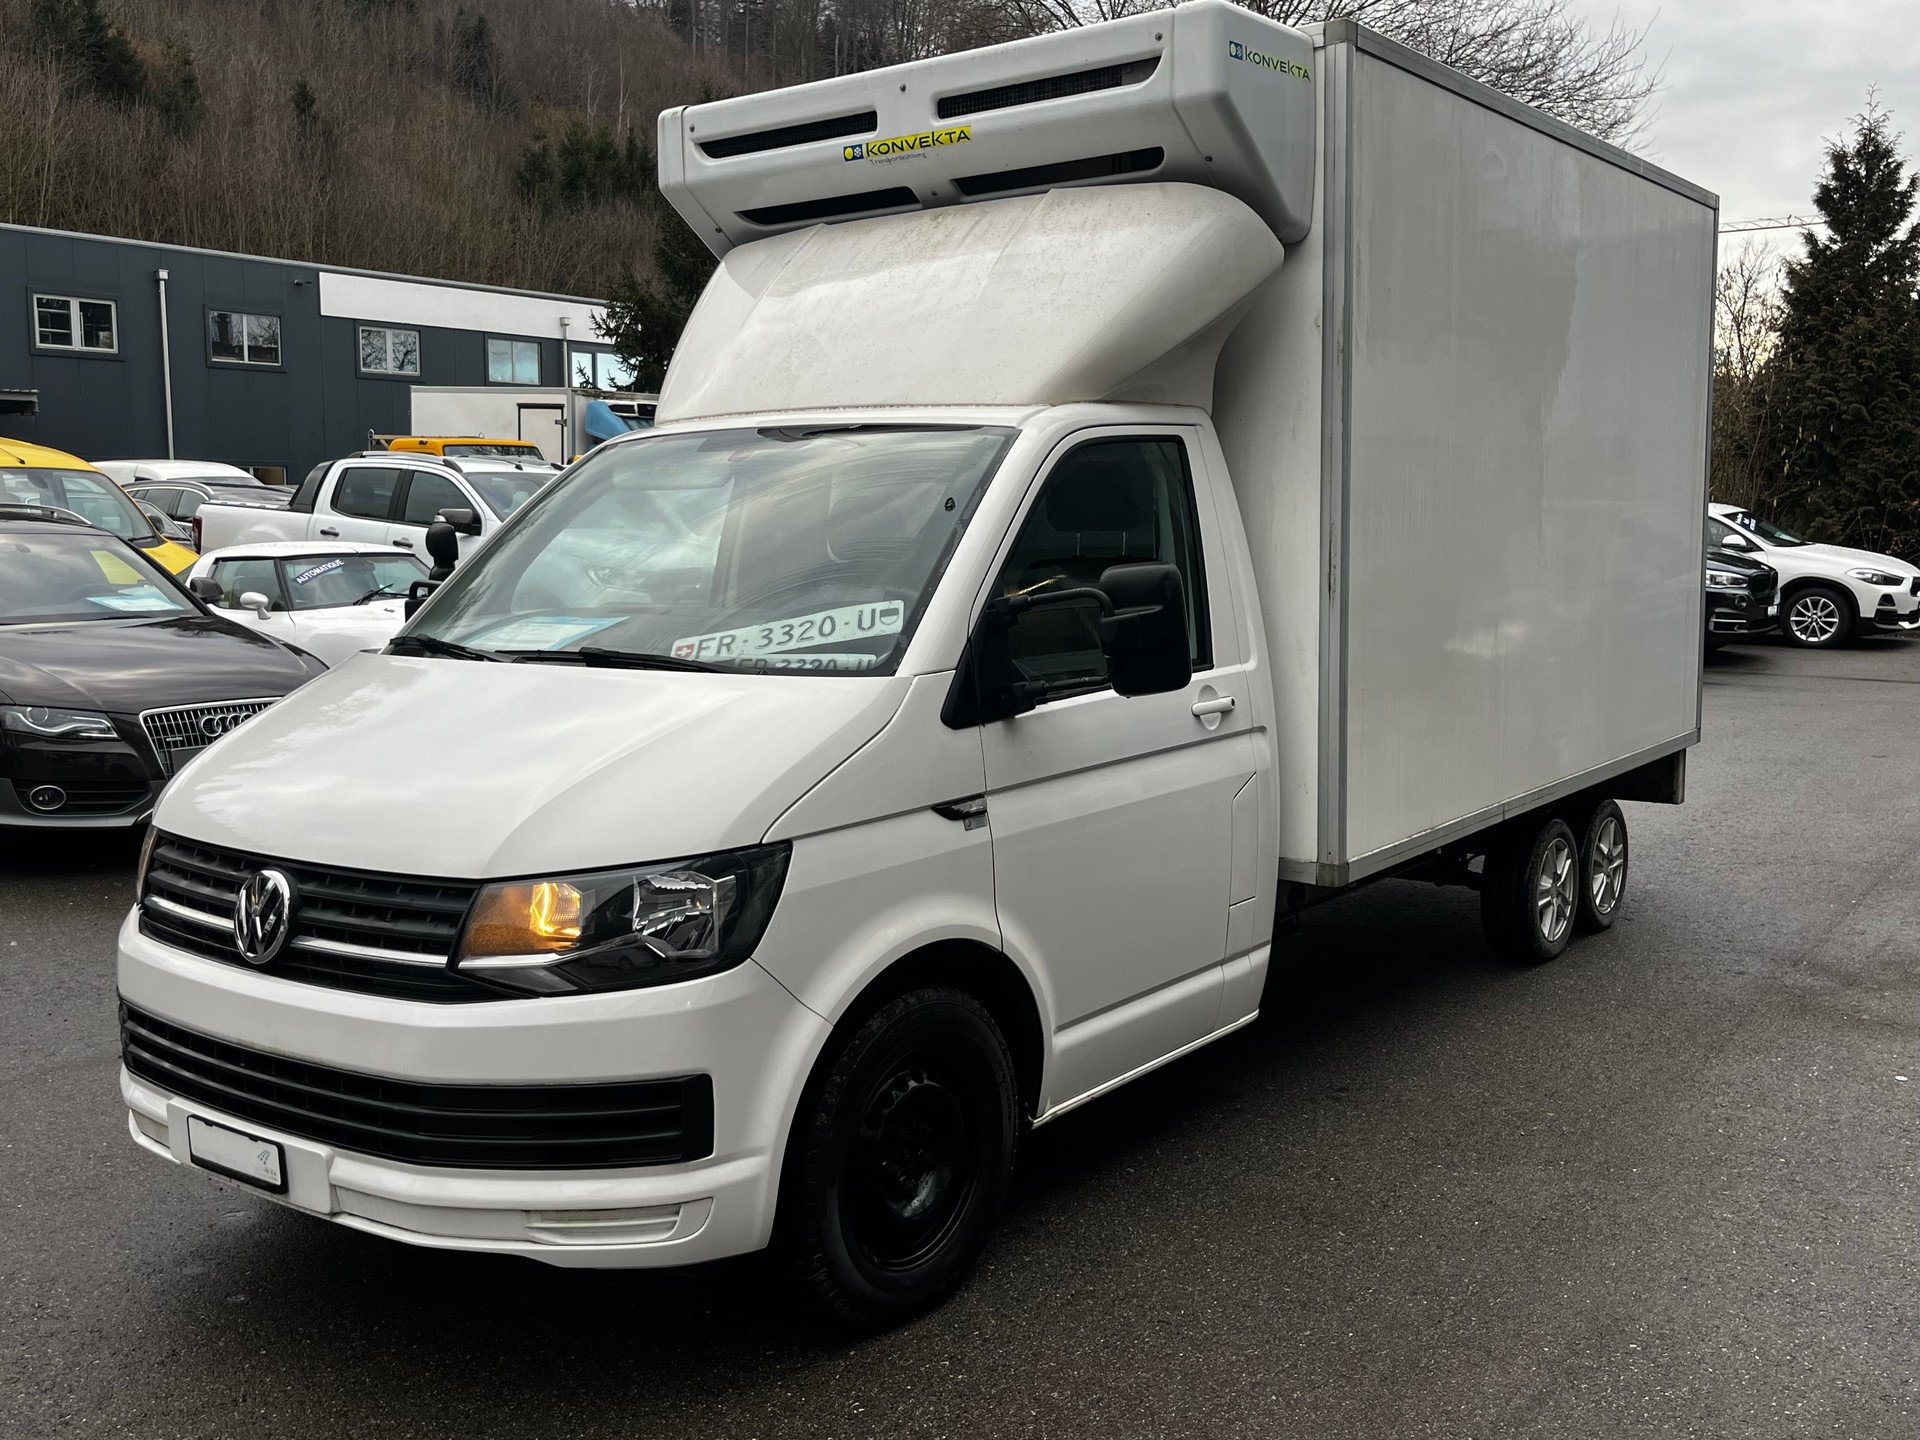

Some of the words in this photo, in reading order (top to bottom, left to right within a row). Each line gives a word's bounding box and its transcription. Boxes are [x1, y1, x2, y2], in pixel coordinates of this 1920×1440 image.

[1245, 45, 1311, 82] KONVEKTA
[866, 129, 971, 158] KONVEKTA
[296, 559, 345, 584] AUTOMATIQUE
